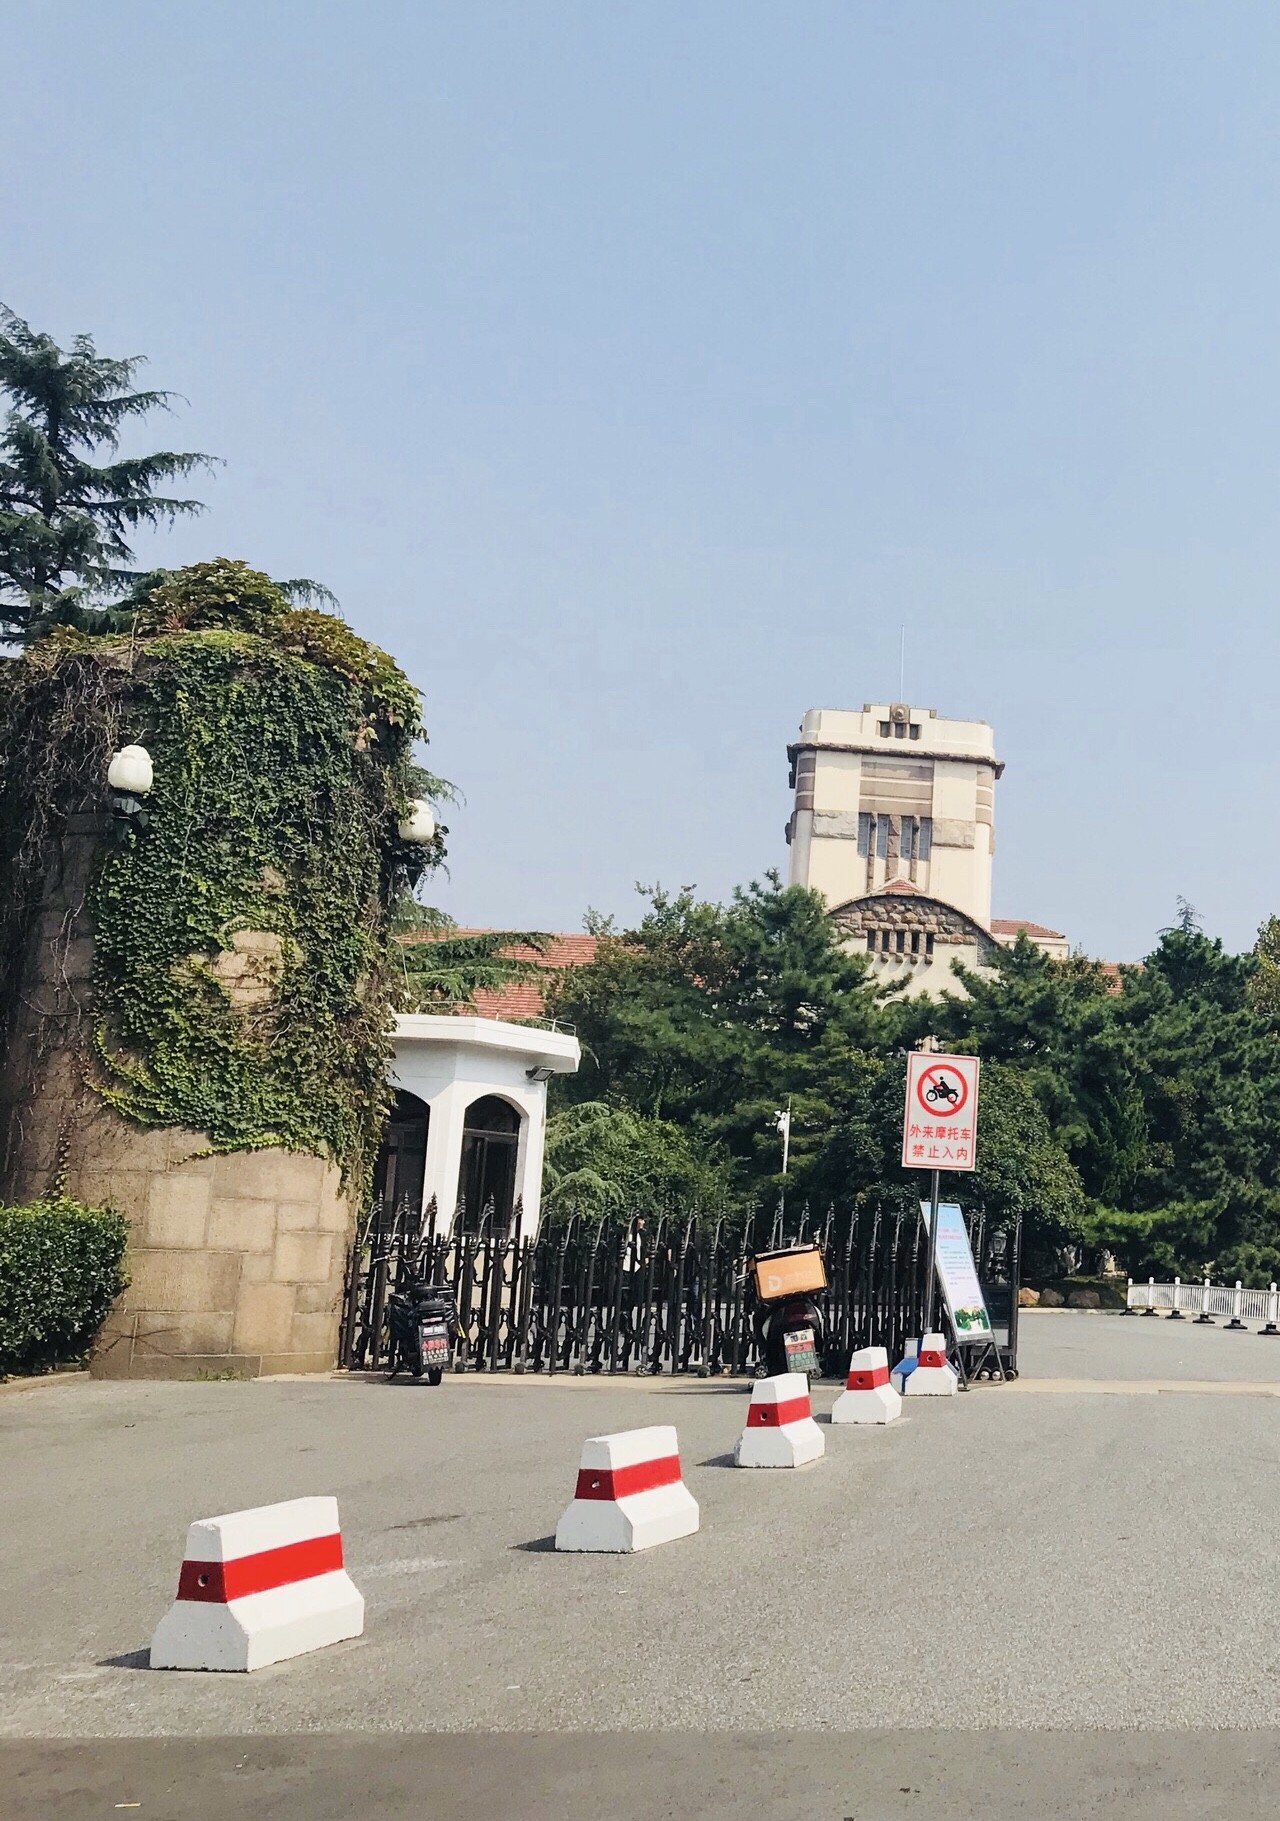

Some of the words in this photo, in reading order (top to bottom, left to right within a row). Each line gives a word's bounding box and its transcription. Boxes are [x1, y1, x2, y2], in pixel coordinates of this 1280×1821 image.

[909, 1123, 972, 1141] 外来摩托车
[911, 1144, 969, 1161] 禁止入内
